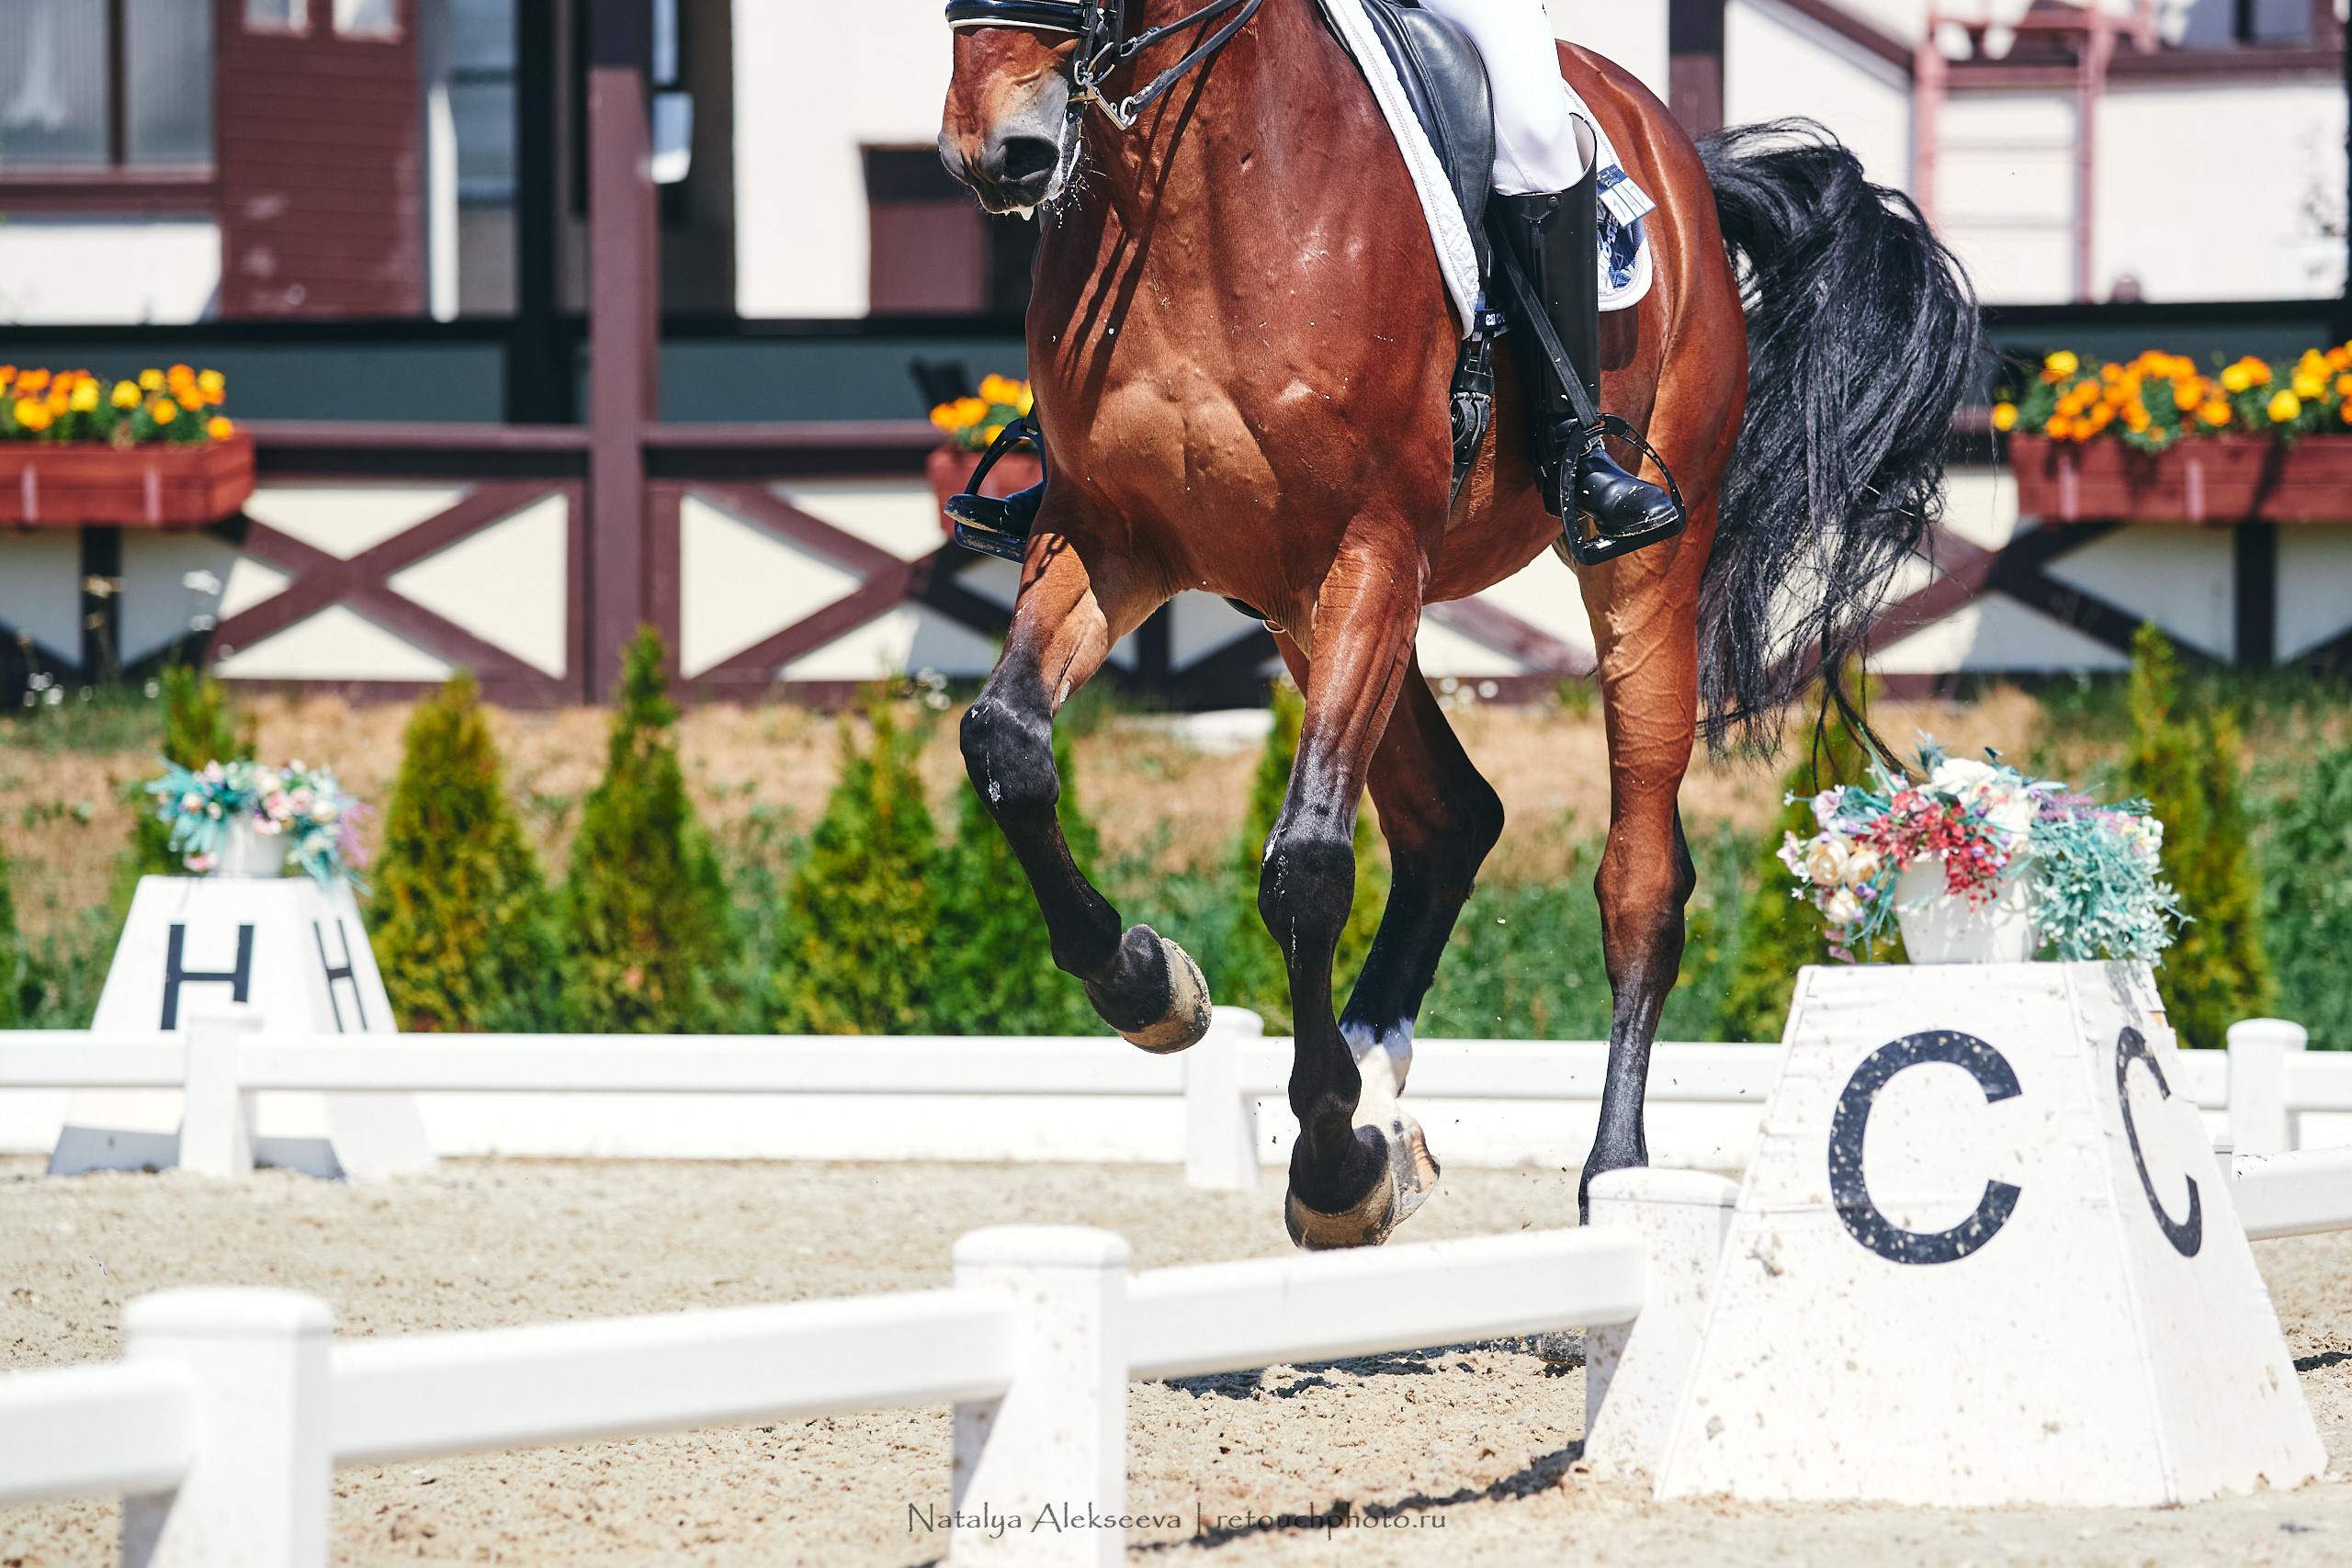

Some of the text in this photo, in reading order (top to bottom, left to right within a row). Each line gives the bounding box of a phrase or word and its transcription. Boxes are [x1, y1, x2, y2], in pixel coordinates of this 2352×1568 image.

[160, 924, 254, 1031] H
[314, 919, 368, 1033] H
[1828, 1030, 2023, 1266] C
[2116, 1026, 2202, 1258] C
